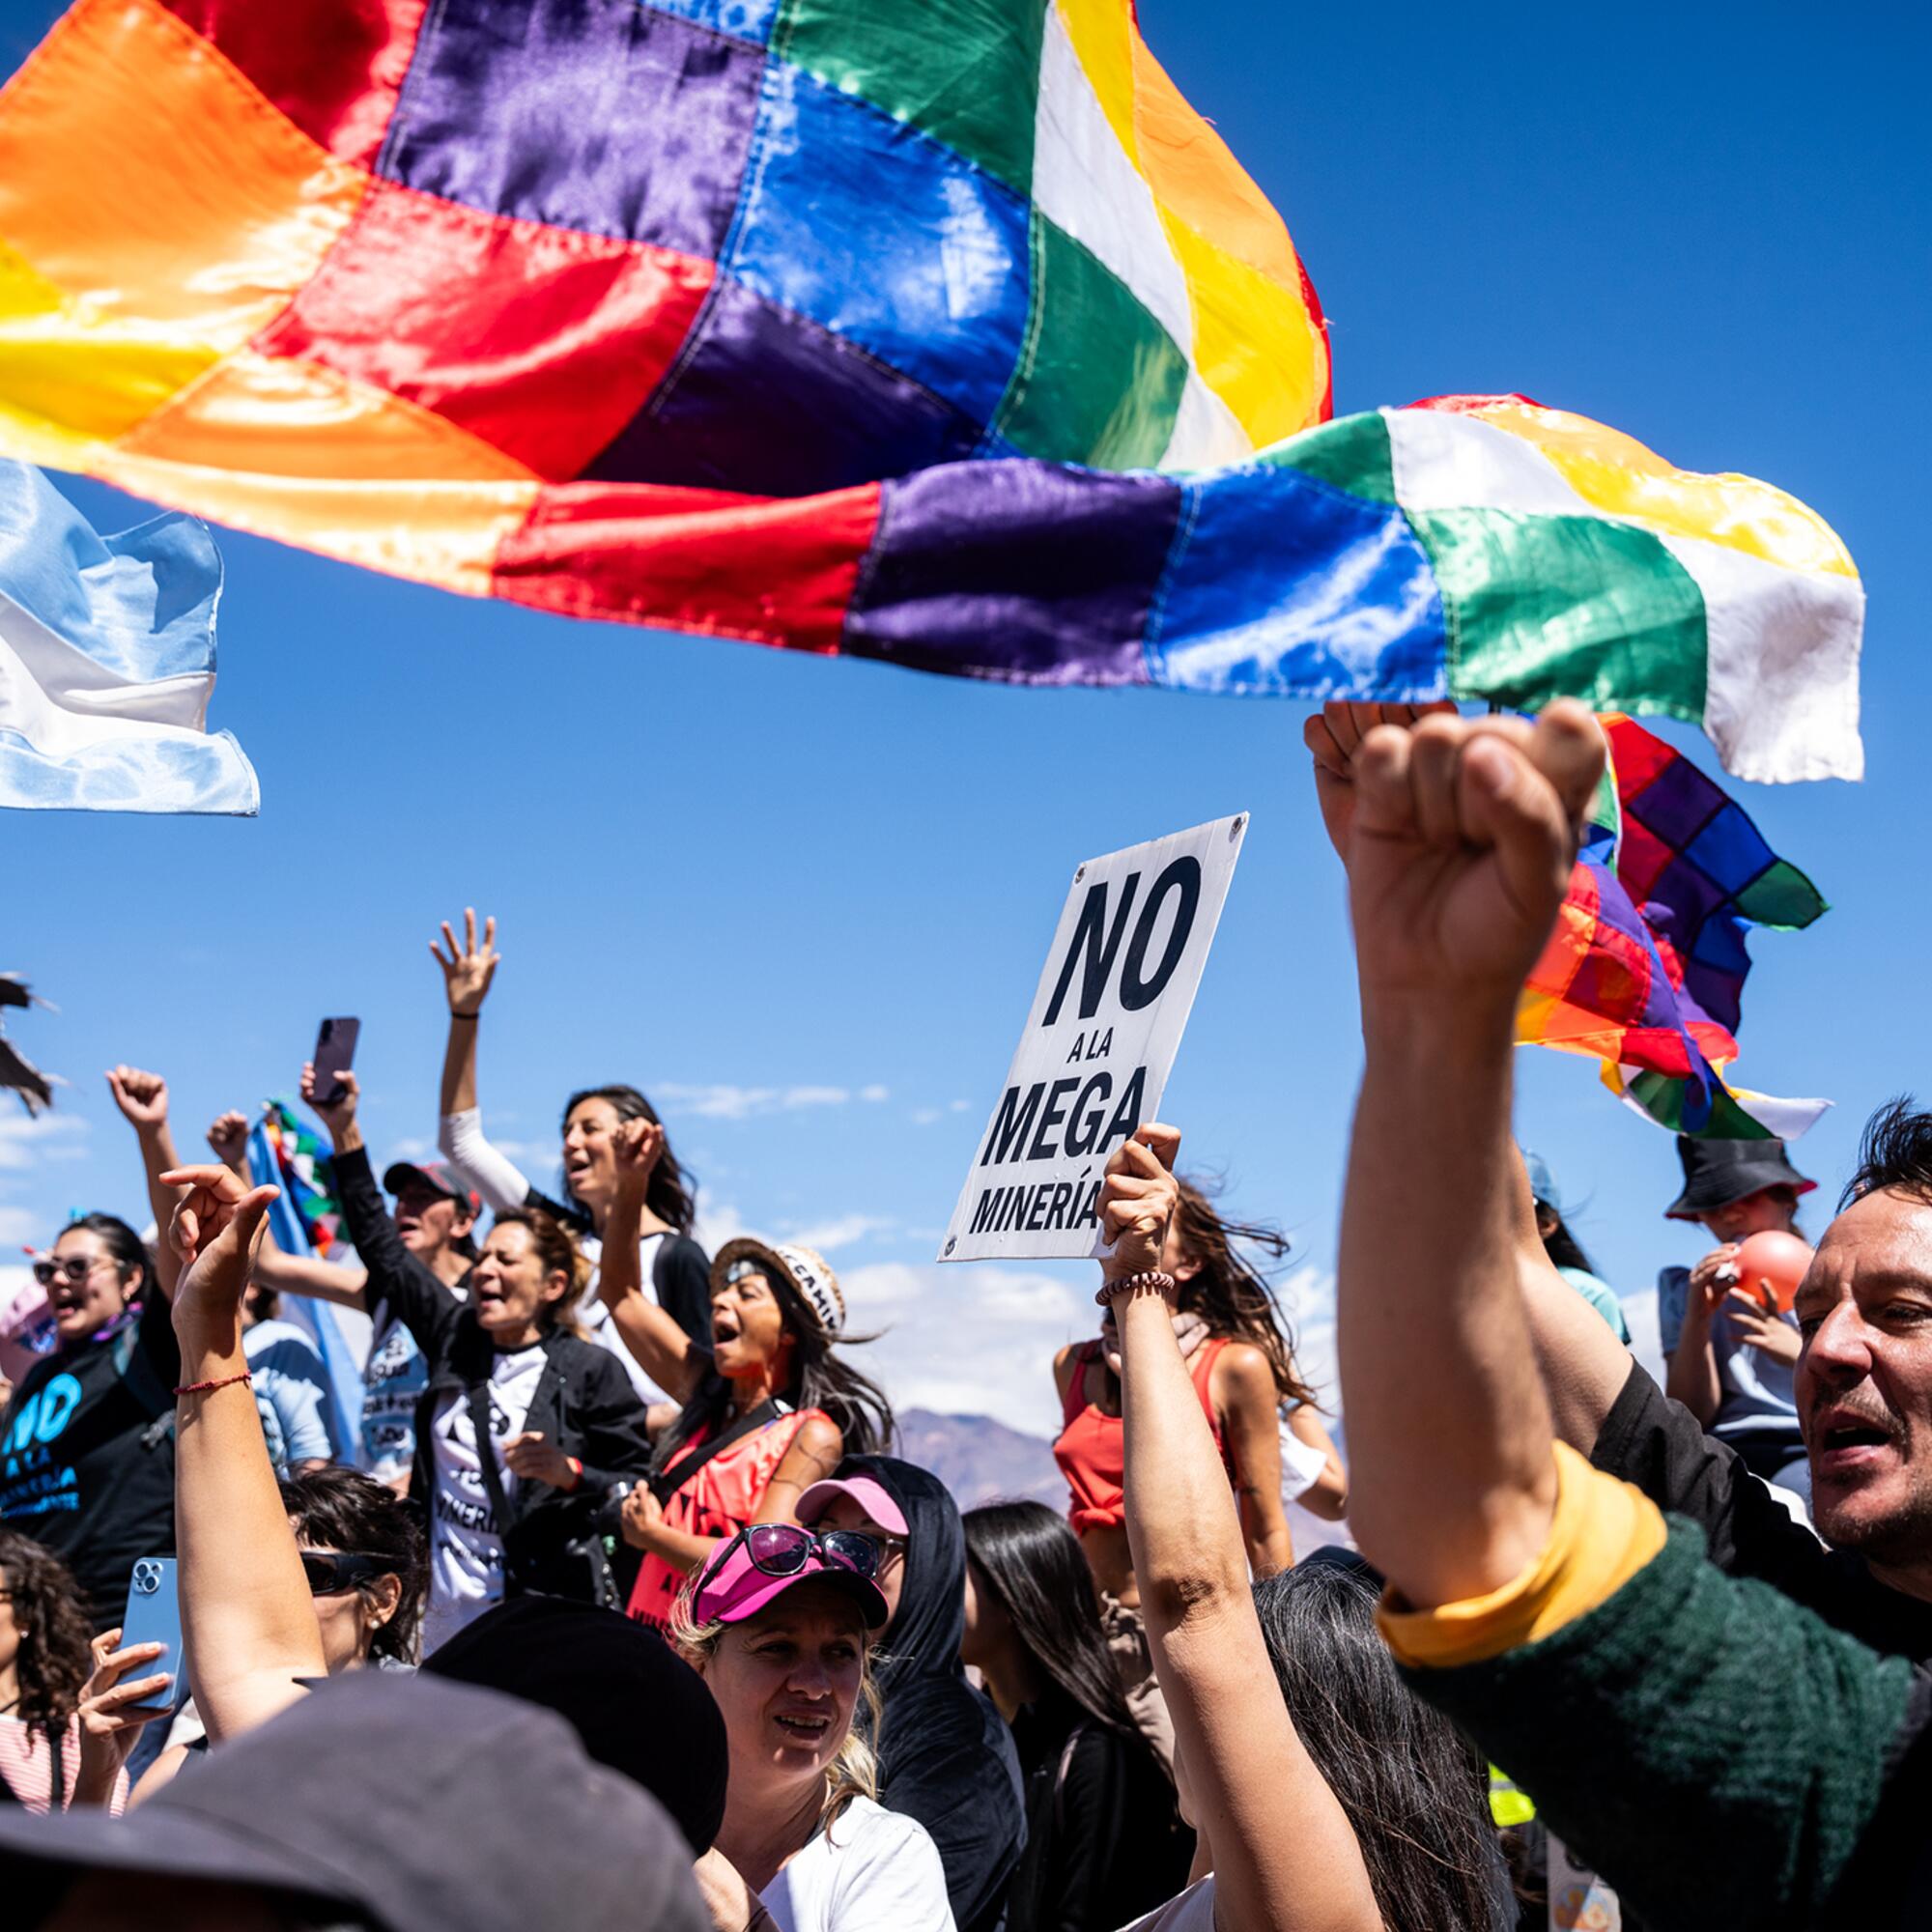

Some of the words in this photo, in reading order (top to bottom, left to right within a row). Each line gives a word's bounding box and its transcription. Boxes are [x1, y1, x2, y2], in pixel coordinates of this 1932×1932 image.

[1041, 855, 1201, 1027] NO
[1066, 1032, 1086, 1064] A
[1086, 1027, 1115, 1060] LA
[980, 1065, 1147, 1167] MEGA
[968, 1165, 1103, 1235] MINERÍA
[1, 1372, 82, 1456] NO
